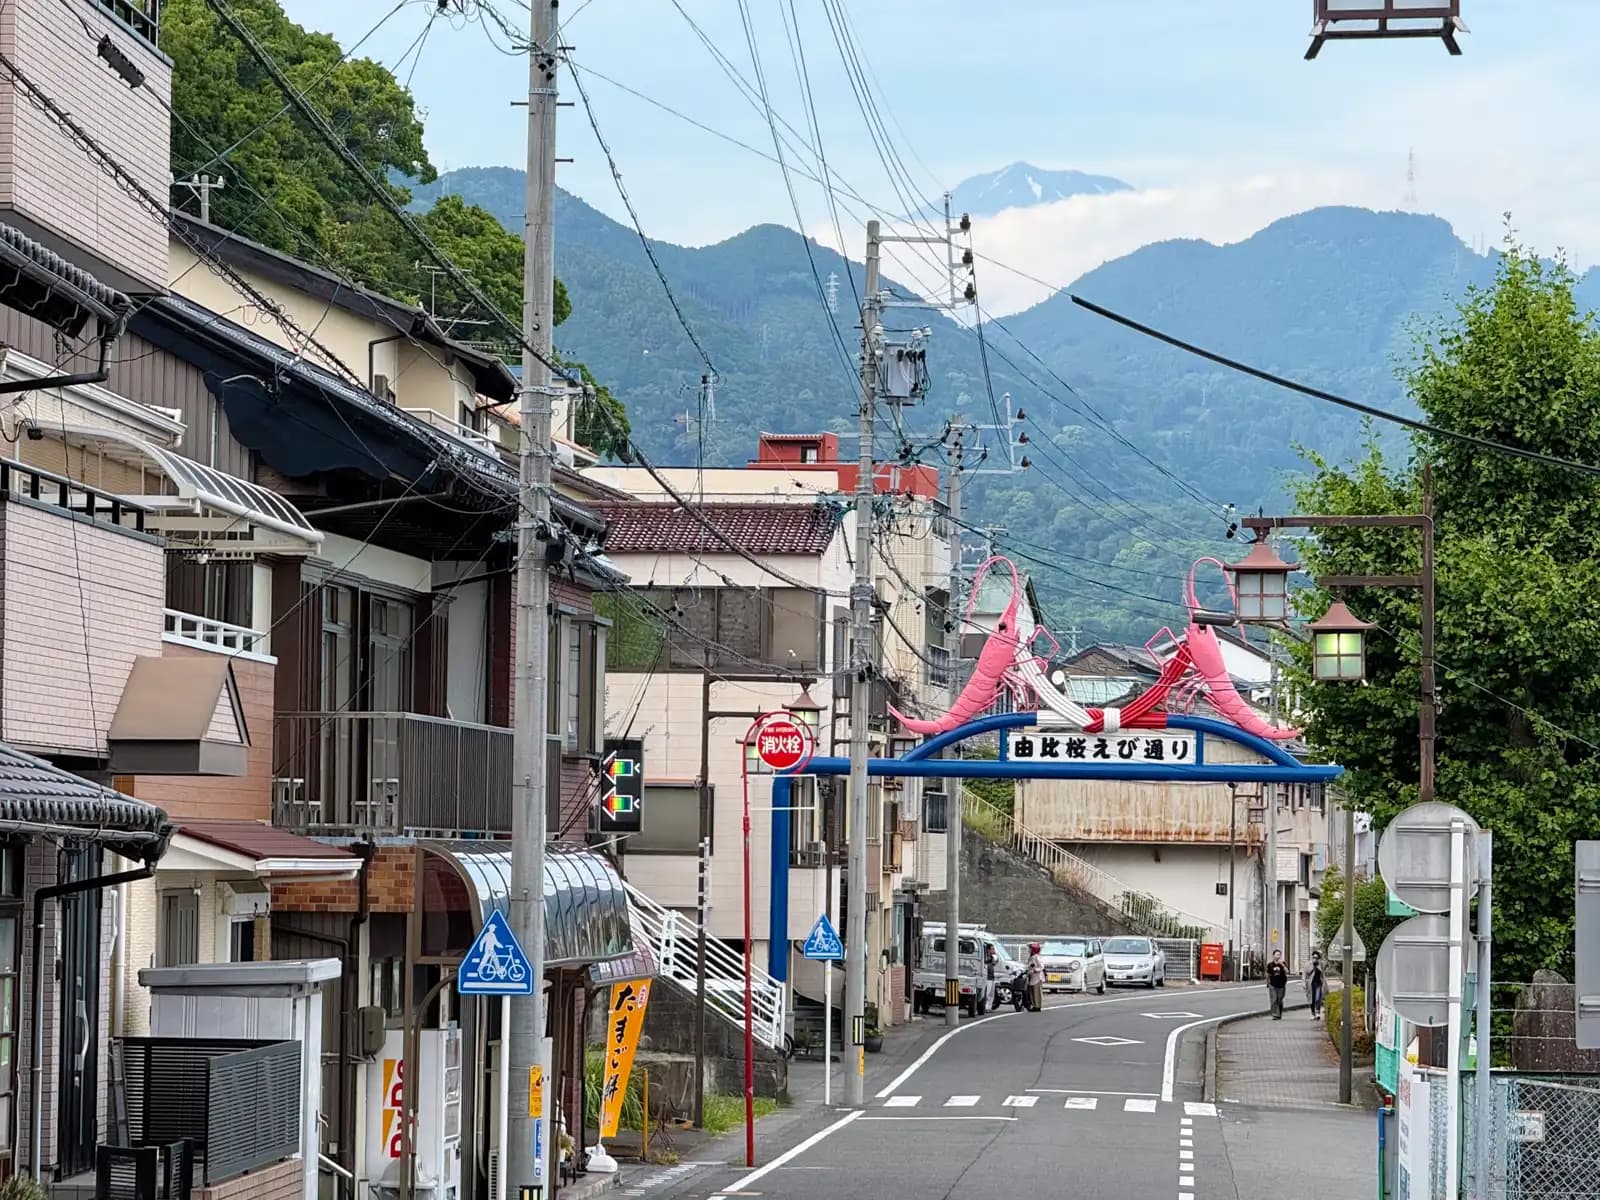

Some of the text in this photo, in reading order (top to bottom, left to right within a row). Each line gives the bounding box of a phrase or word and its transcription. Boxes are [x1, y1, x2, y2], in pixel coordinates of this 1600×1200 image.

[761, 735, 801, 754] 消火栓
[1014, 736, 1189, 760] 由比桜えび通り
